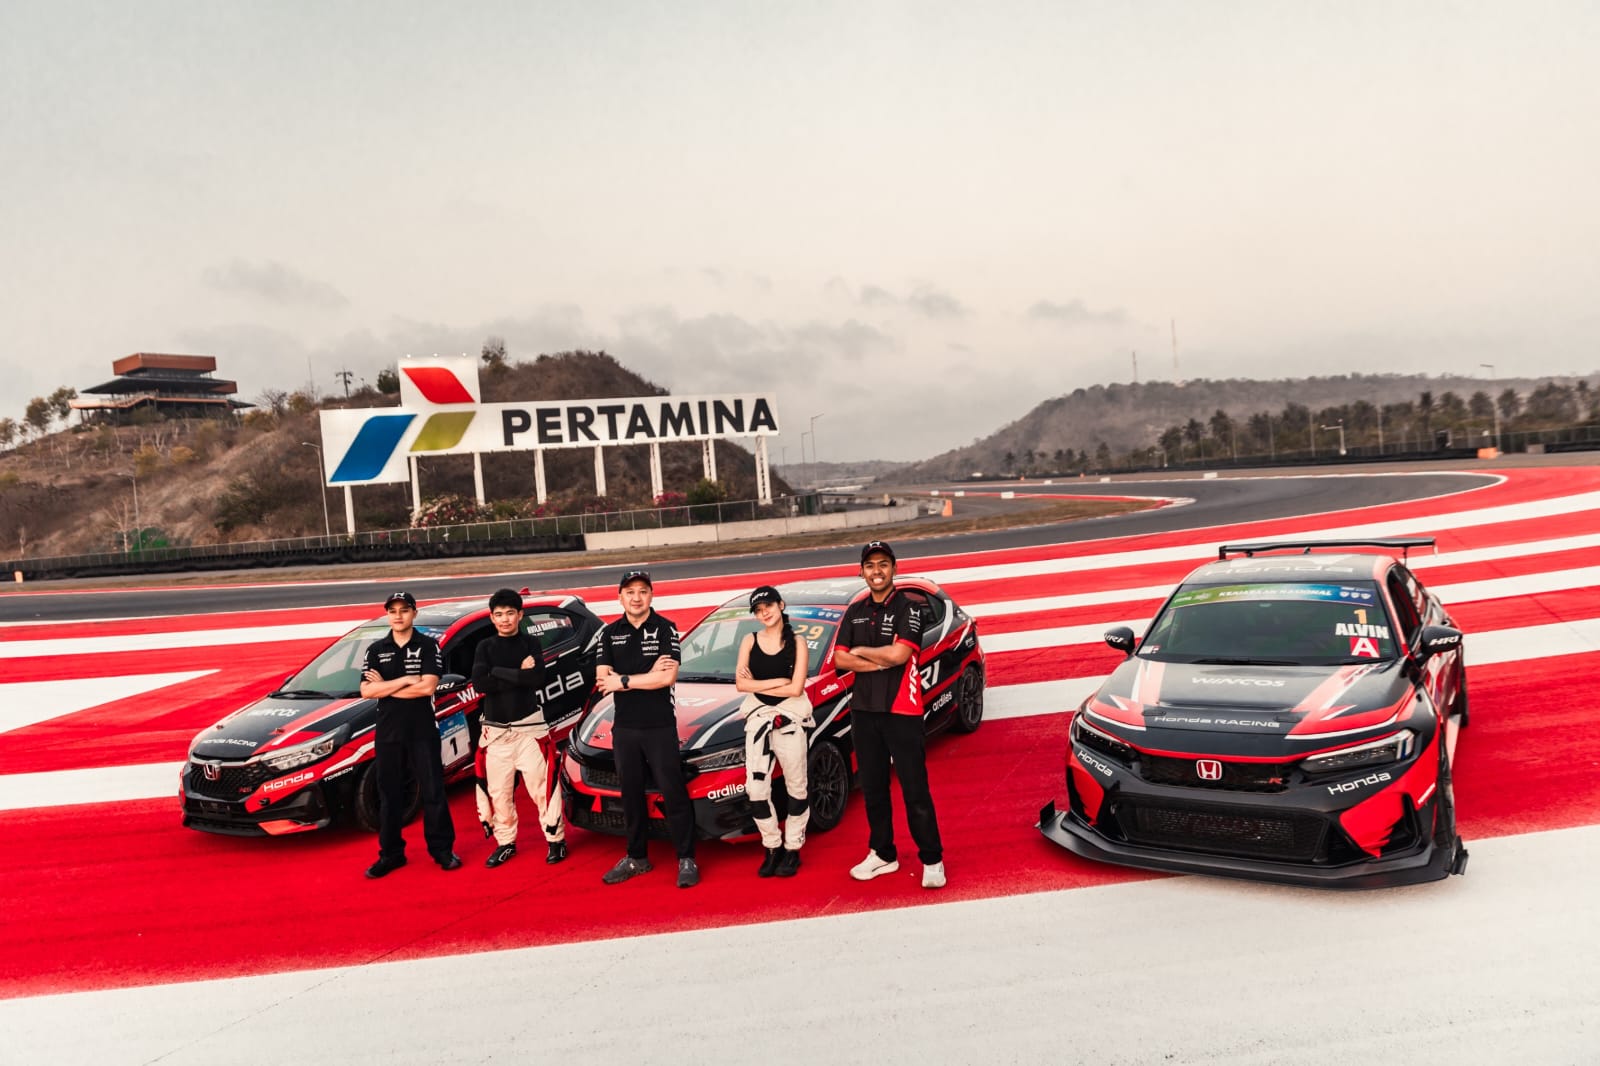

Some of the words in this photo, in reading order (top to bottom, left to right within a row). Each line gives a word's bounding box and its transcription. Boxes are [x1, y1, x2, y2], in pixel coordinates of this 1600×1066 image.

[502, 398, 778, 446] PERTAMINA
[1354, 609, 1367, 624] 1
[793, 624, 824, 640] 29
[1335, 622, 1389, 639] ALVIN
[1351, 638, 1380, 657] A
[919, 659, 941, 690] RI
[1191, 677, 1286, 687] WINCOS
[457, 687, 479, 704] WI
[535, 671, 585, 704] nda
[932, 691, 953, 712] ardiles
[1154, 716, 1212, 724] Honda
[1214, 719, 1280, 728] RACING
[450, 736, 459, 756] 1
[1077, 750, 1113, 777] Honda
[263, 771, 315, 792] Honda
[1327, 772, 1392, 795] Honda
[707, 783, 748, 800] ardile
